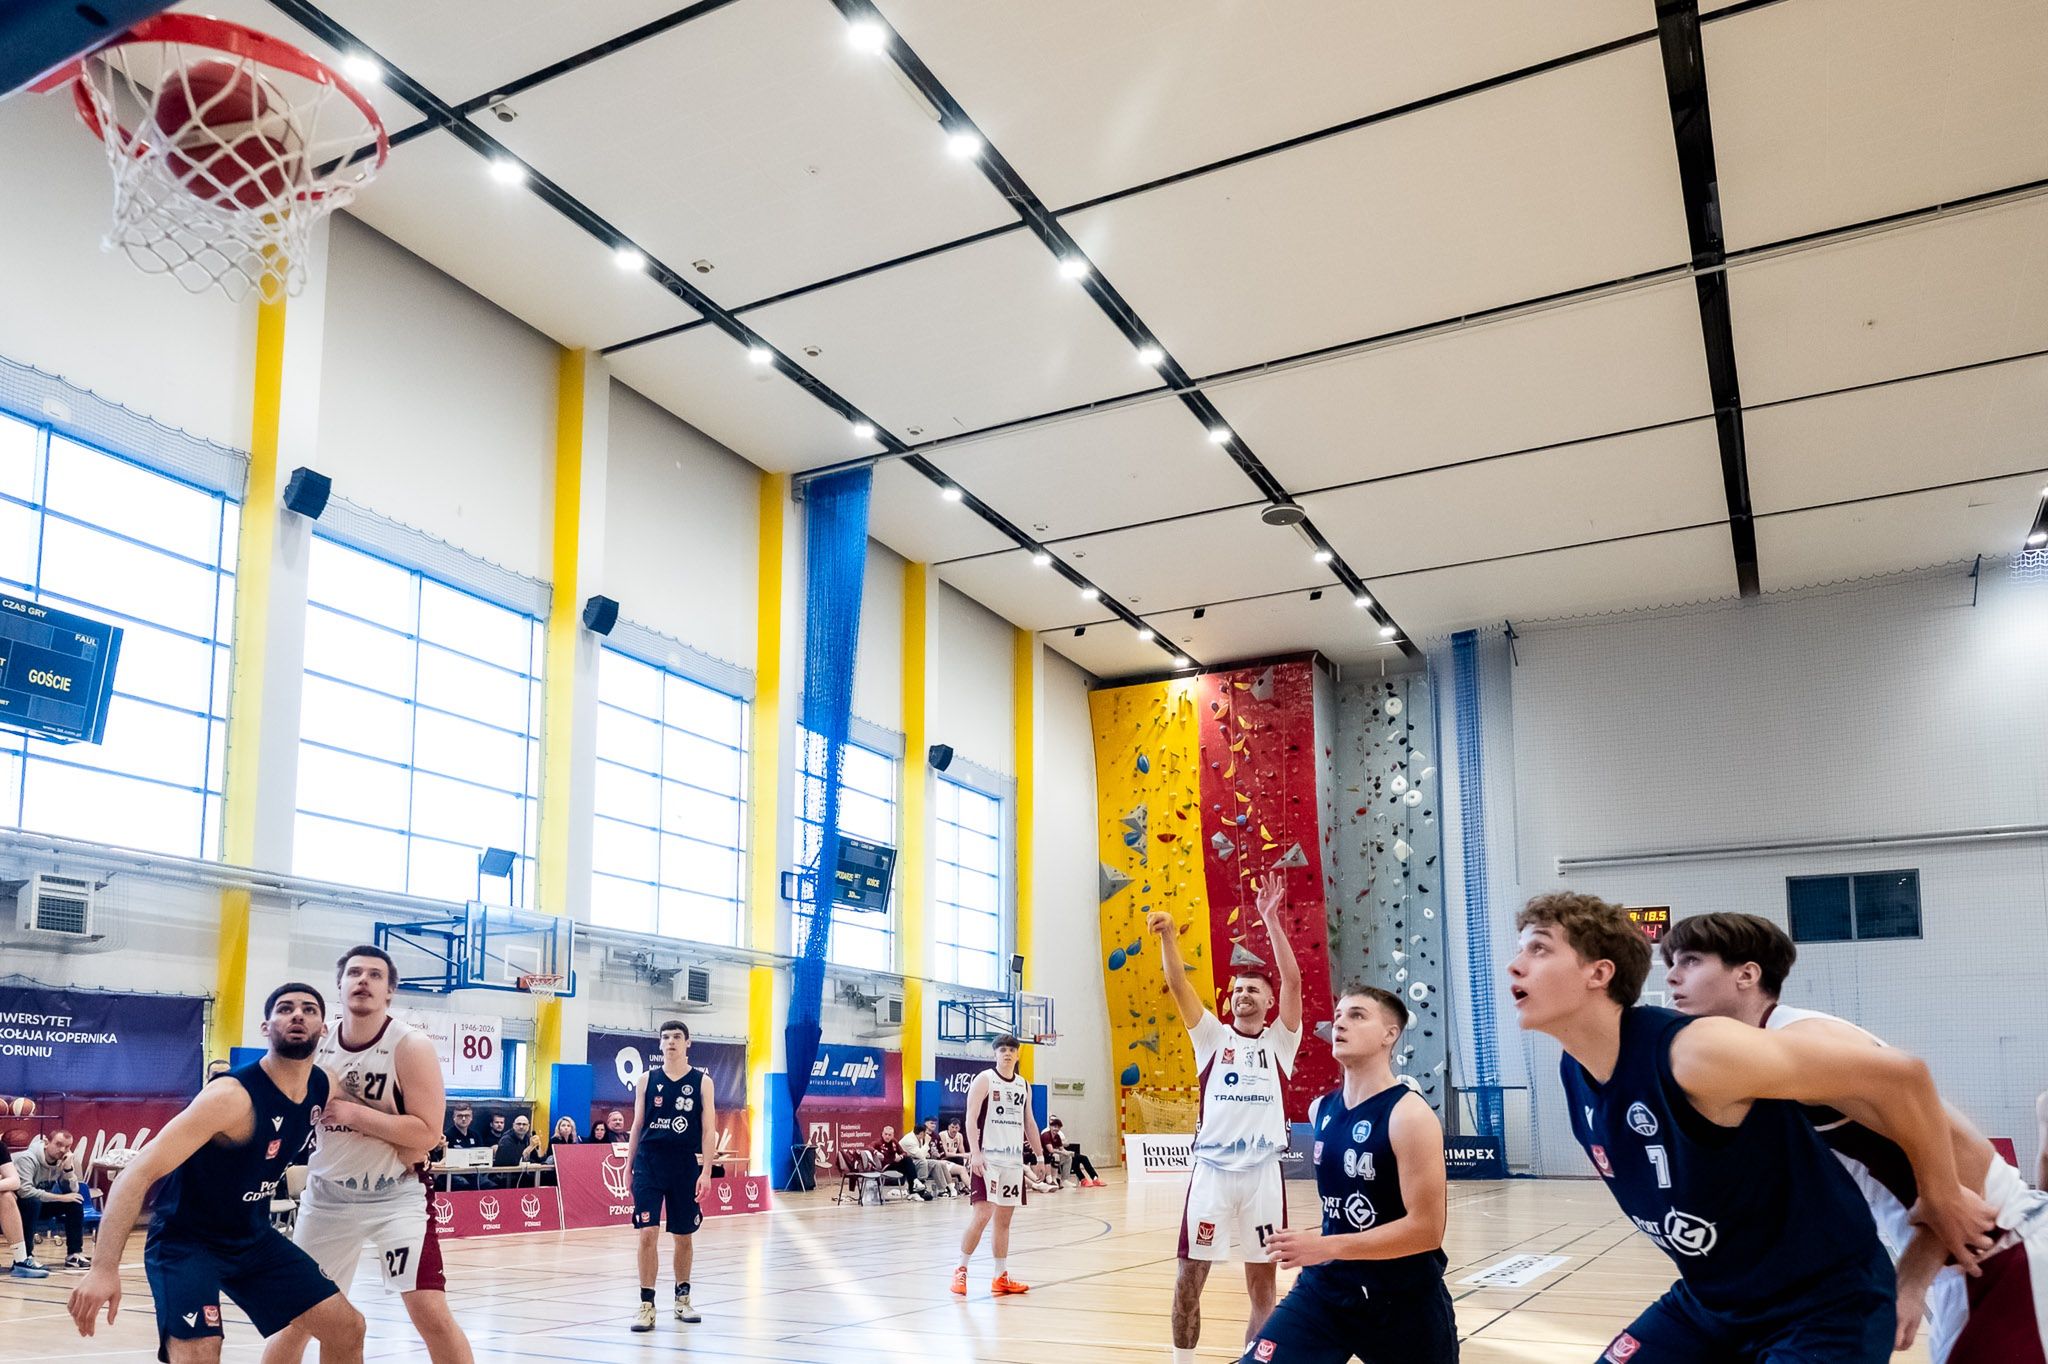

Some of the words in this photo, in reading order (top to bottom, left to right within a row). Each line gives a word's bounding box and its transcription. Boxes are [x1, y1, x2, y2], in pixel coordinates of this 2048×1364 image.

[2, 600, 26, 612] CZAS
[28, 607, 47, 618] GRY
[75, 633, 97, 646] FAUL
[28, 669, 72, 692] GOŚCIE
[461, 1023, 495, 1033] 1946-2026
[46, 1031, 118, 1044] KOPERNIKA
[463, 1034, 493, 1060] 80
[471, 1064, 483, 1072] LAT
[364, 1072, 387, 1101] 27
[675, 1096, 694, 1112] 33
[1014, 1093, 1025, 1106] 24
[1143, 1142, 1190, 1156] leman
[1144, 1155, 1189, 1167] invest
[1343, 1148, 1376, 1180] 94
[1003, 1184, 1019, 1198] 24
[385, 1246, 410, 1277] 27
